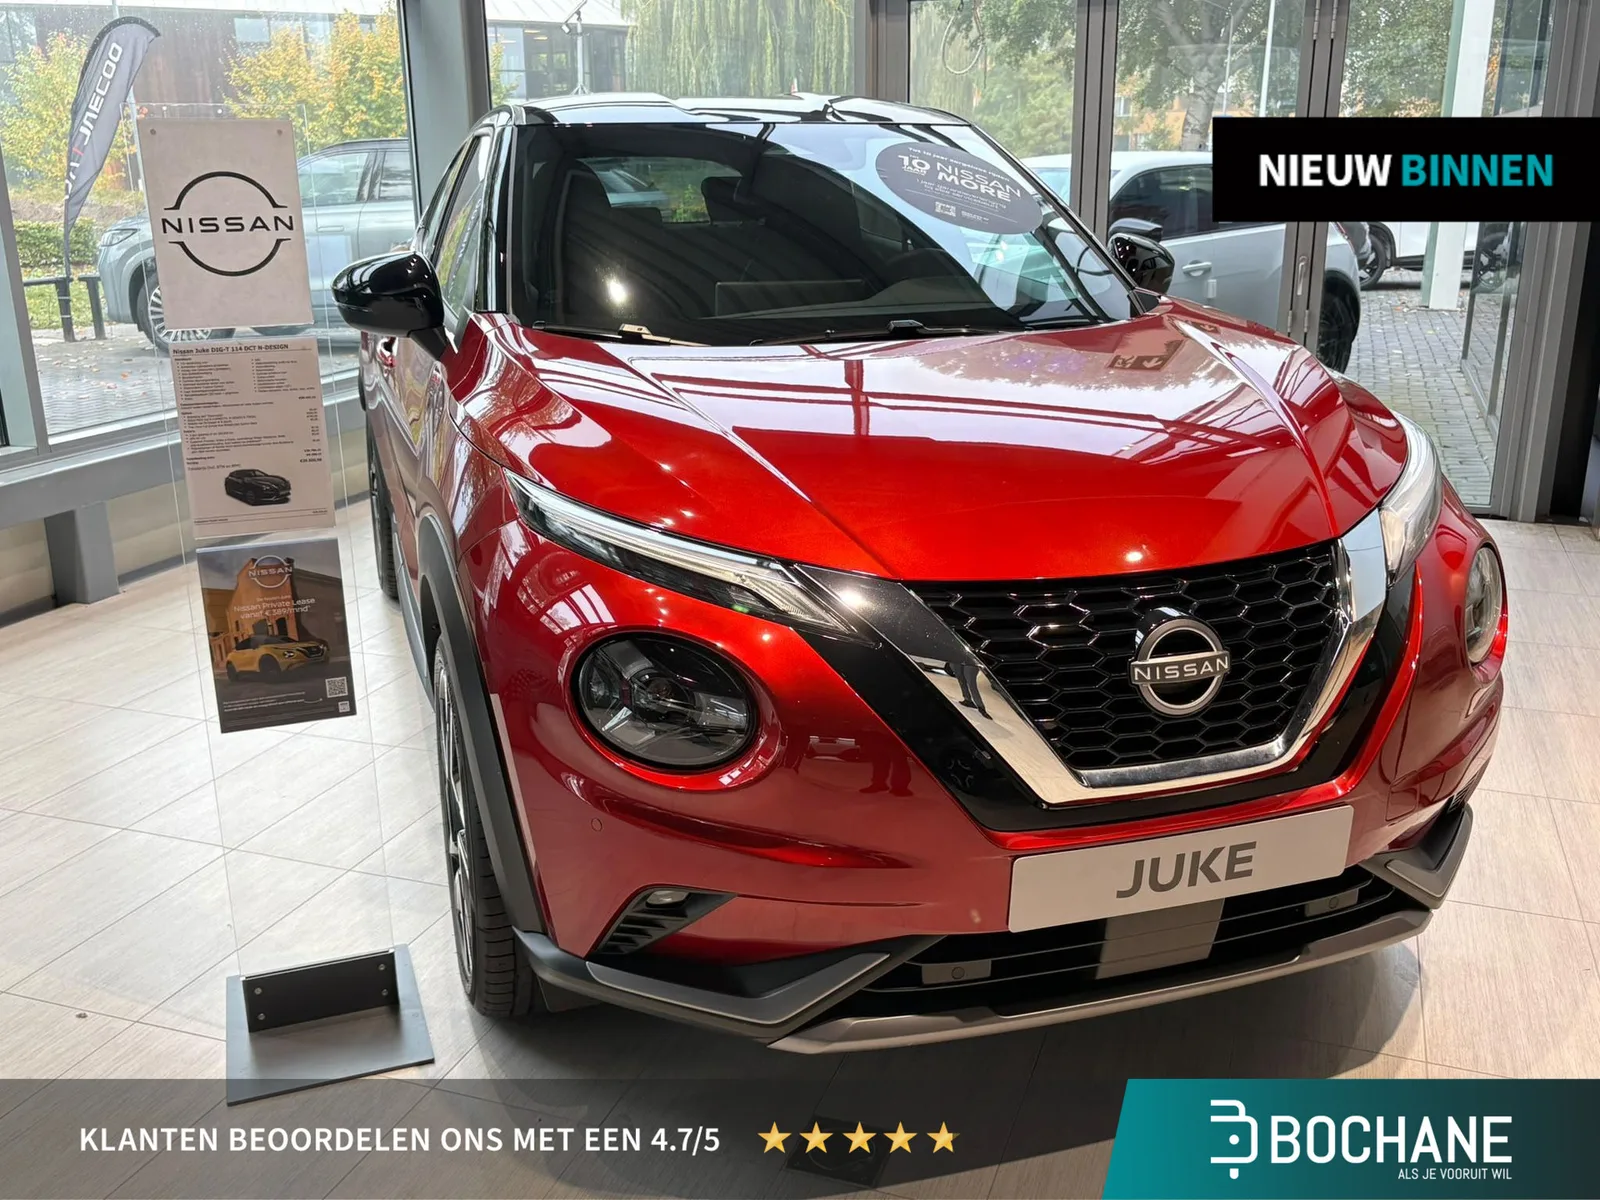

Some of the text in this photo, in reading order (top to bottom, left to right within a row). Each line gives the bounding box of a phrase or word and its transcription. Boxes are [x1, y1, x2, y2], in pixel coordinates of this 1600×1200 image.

[79, 42, 123, 146] JAECOO
[898, 154, 931, 171] 10
[936, 161, 1021, 198] NISSAN
[937, 171, 1012, 202] MORE
[161, 215, 294, 234] NISSAN
[257, 343, 289, 351] N-DESIGN
[248, 566, 293, 578] NISSAN
[233, 603, 261, 613] Nissan
[262, 600, 291, 610] Private
[292, 598, 316, 606] Lease
[1133, 655, 1230, 681] NISSAN
[1115, 841, 1257, 899] JUKE
